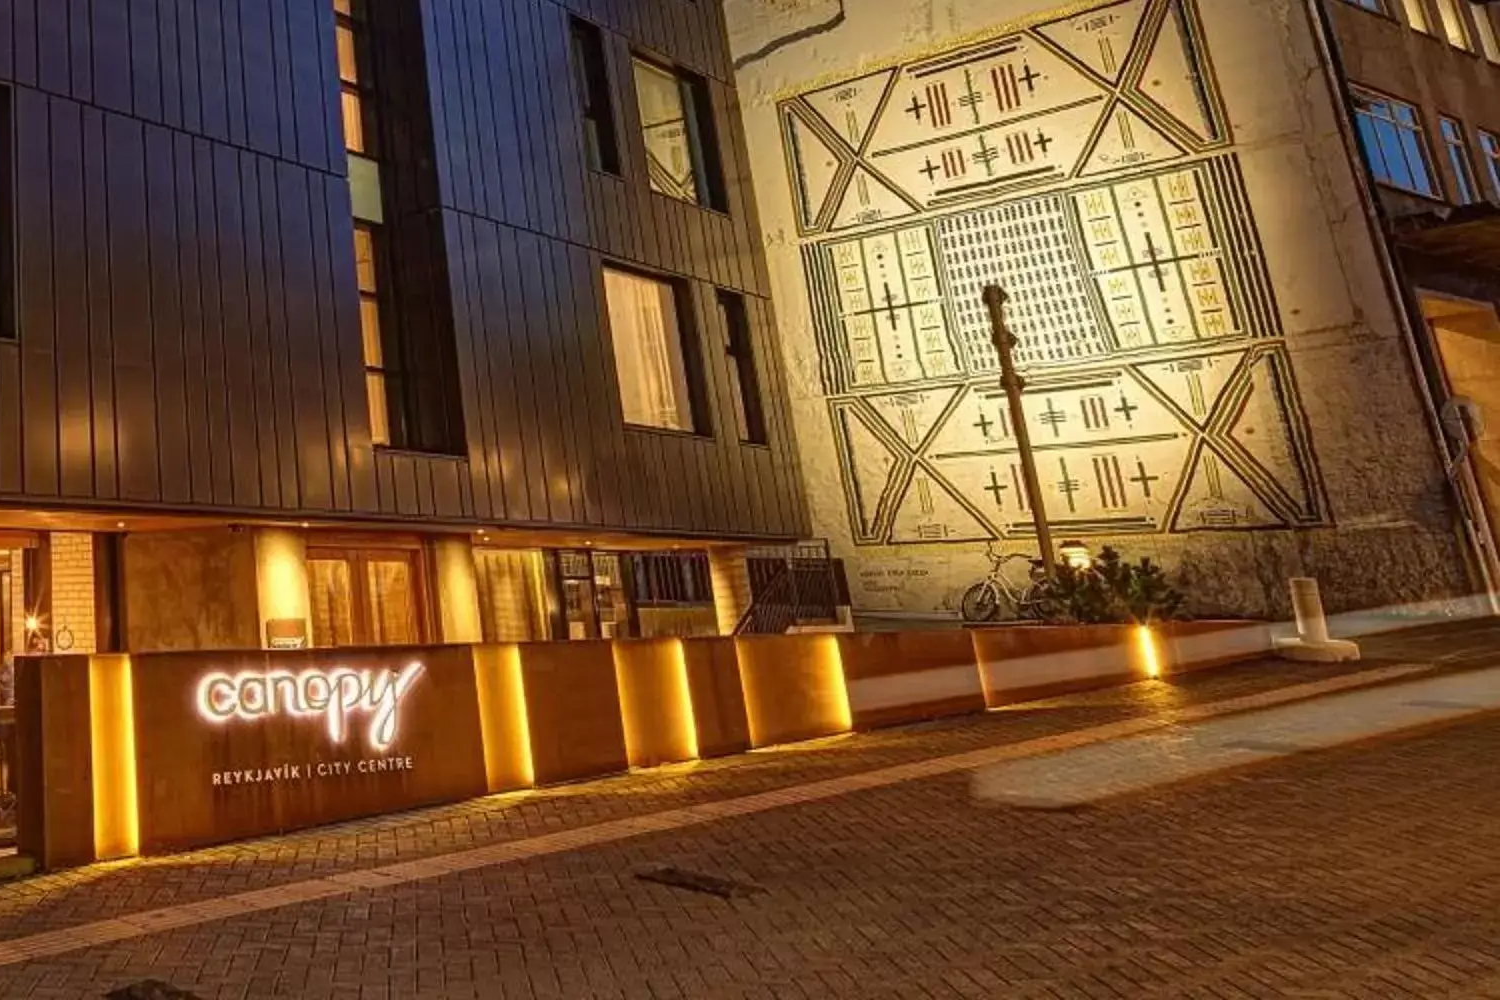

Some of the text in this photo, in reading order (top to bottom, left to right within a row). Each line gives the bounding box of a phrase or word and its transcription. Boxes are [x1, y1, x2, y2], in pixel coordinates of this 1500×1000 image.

[196, 661, 426, 750] canopy
[317, 761, 350, 776] CITY
[357, 756, 414, 773] CENTRE
